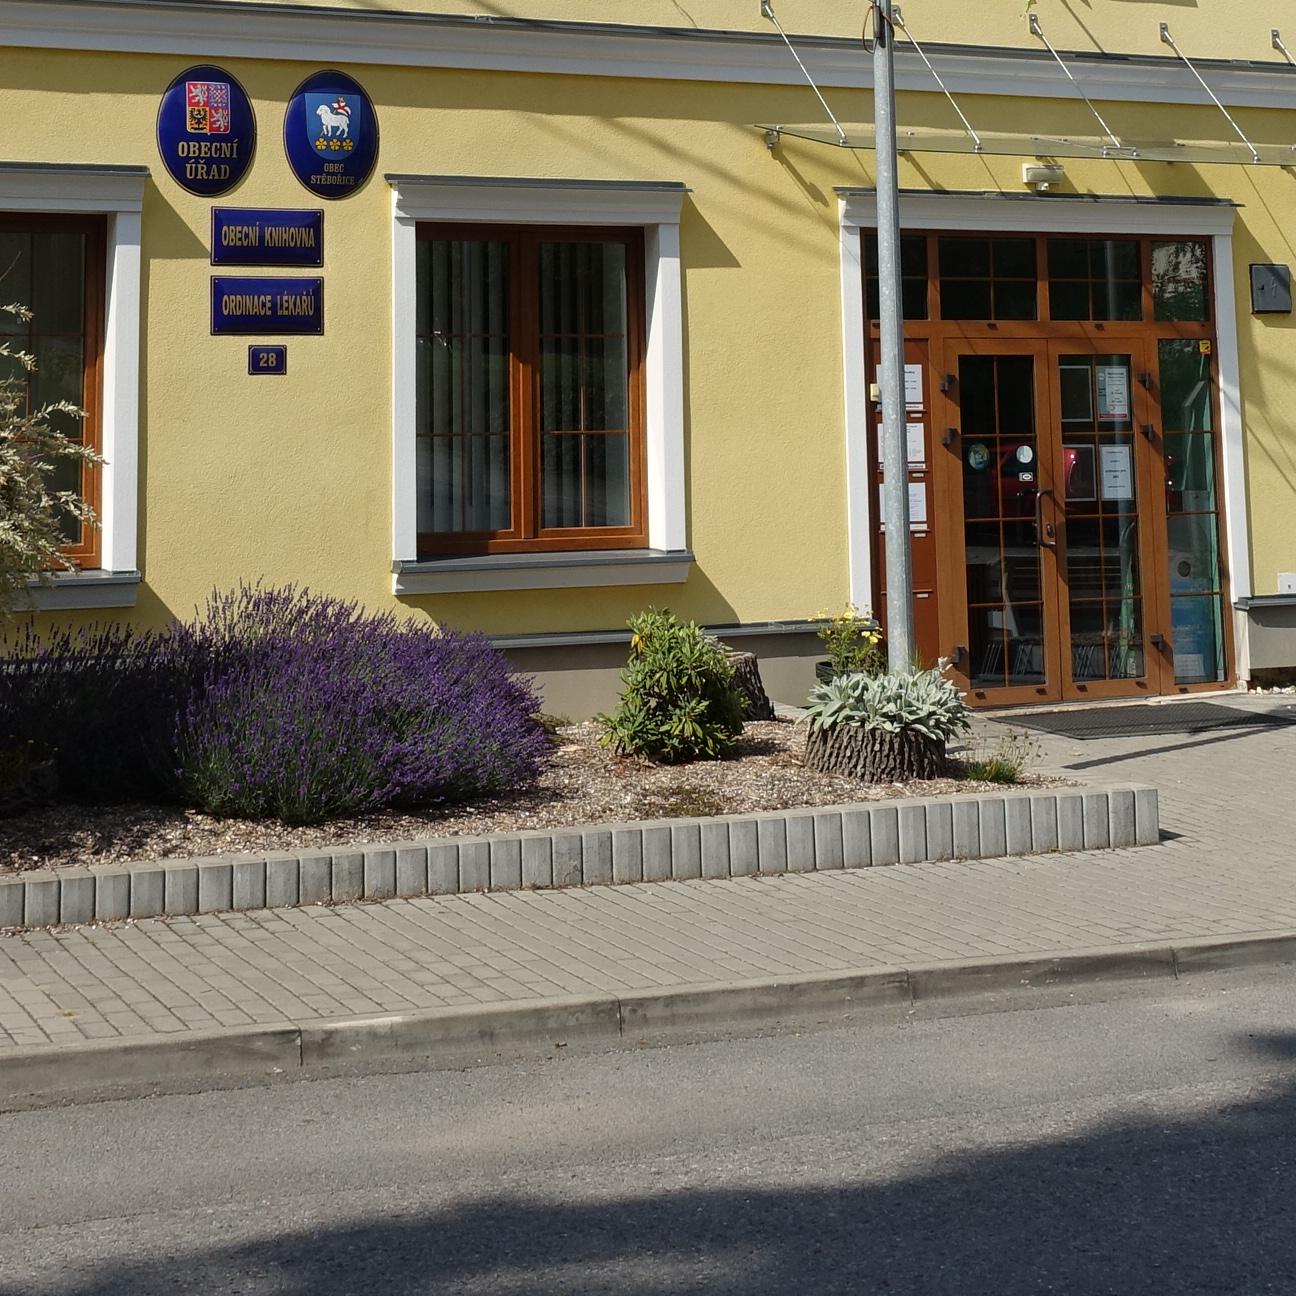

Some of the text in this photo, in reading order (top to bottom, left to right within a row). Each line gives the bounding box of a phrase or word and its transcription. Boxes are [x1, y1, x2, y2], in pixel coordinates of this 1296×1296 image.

[178, 138, 238, 158] OBECNÍ
[186, 159, 230, 179] ÚŘAD
[324, 163, 344, 173] OBEC
[310, 174, 355, 185] STĚBOŘICE
[221, 221, 315, 247] OBECNÍ KNIHOVNA
[222, 288, 314, 316] ORDINACE LÉKAŘŮ
[259, 352, 277, 367] 28
